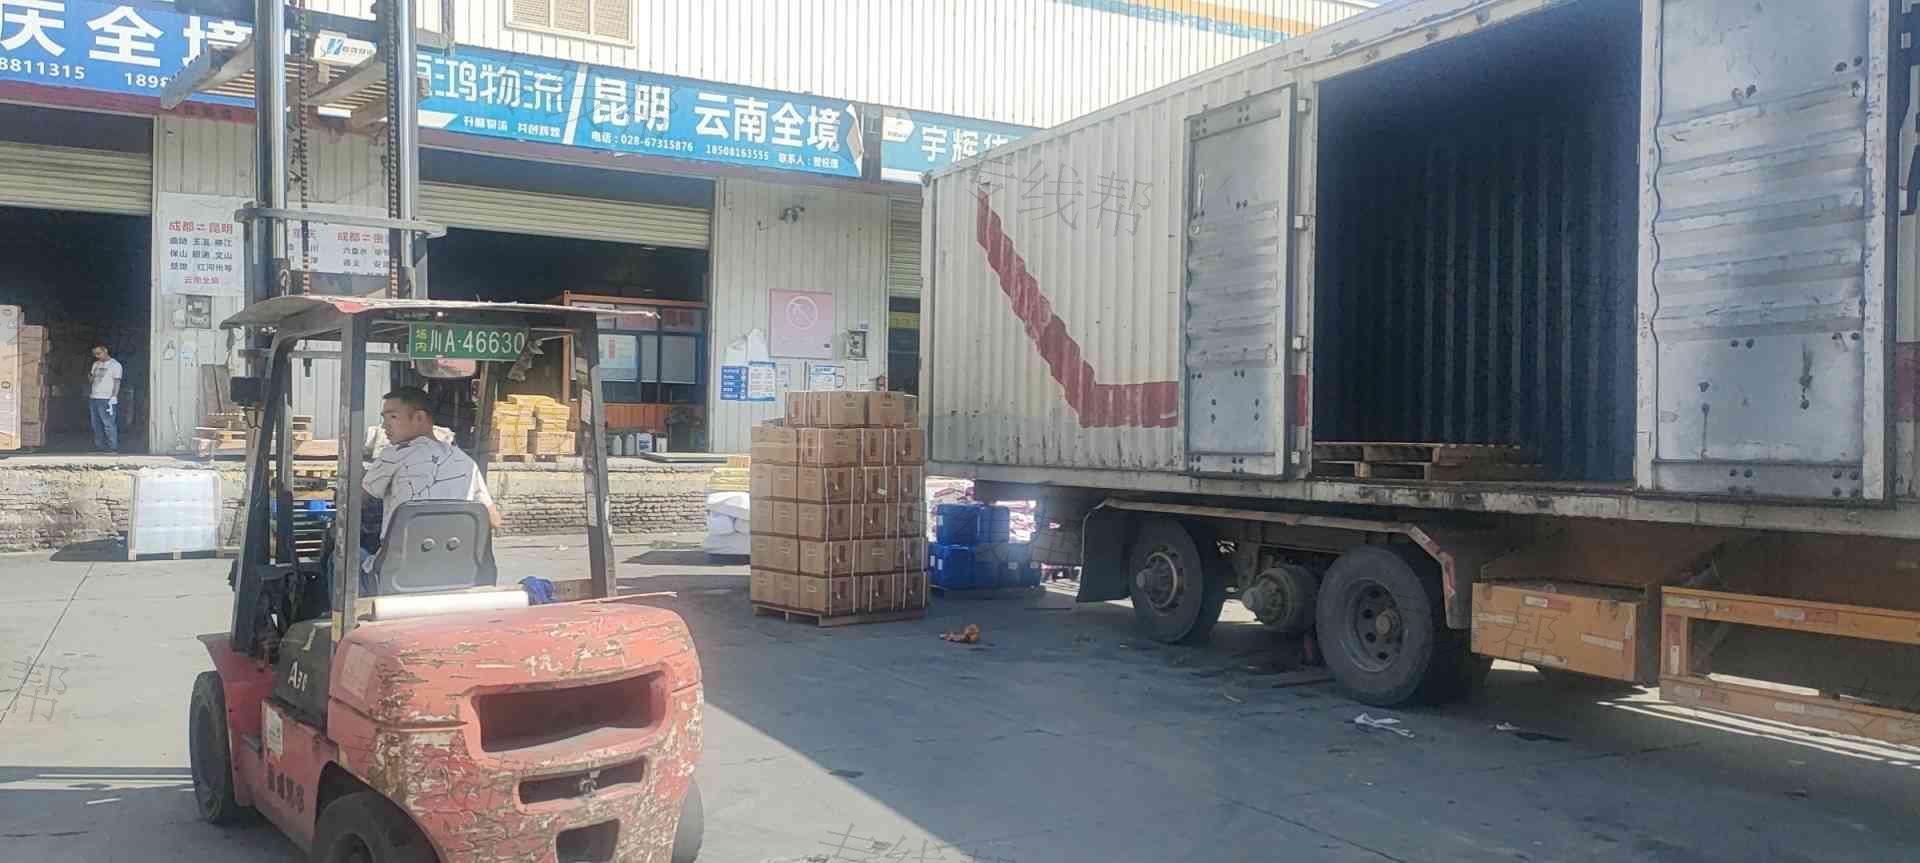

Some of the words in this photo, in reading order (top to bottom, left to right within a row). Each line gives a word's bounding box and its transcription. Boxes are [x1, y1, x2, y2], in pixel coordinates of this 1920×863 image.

[593, 76, 670, 132] 昆明
[694, 92, 840, 153] 云南全境
[169, 221, 194, 232] 成都
[209, 222, 233, 235] 昆明
[337, 231, 361, 241] 成都
